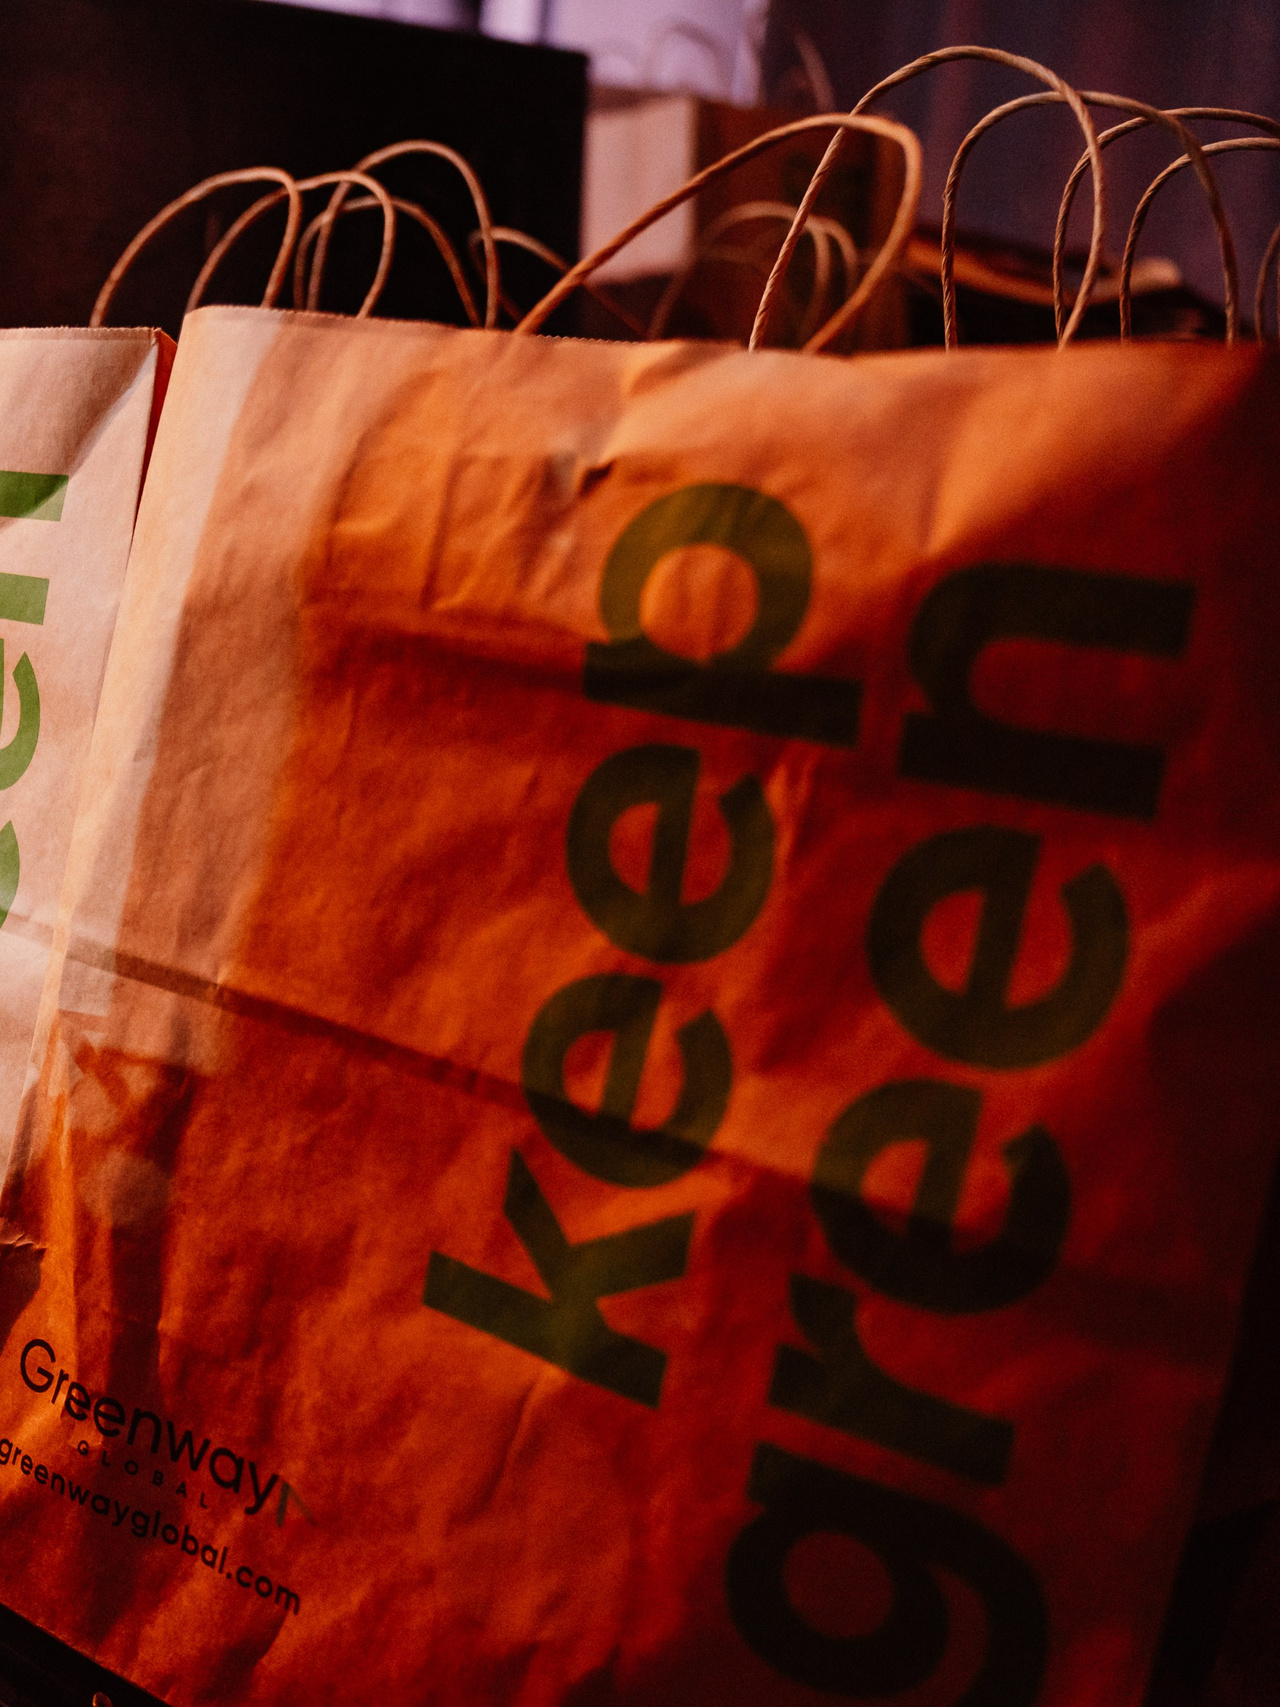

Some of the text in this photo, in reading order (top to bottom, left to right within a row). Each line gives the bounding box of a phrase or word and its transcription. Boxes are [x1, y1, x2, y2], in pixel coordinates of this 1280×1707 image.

[423, 481, 865, 1408] keep
[726, 560, 1199, 1707] green
[20, 1338, 279, 1516] Greenway
[77, 1439, 209, 1510] GLOBAL
